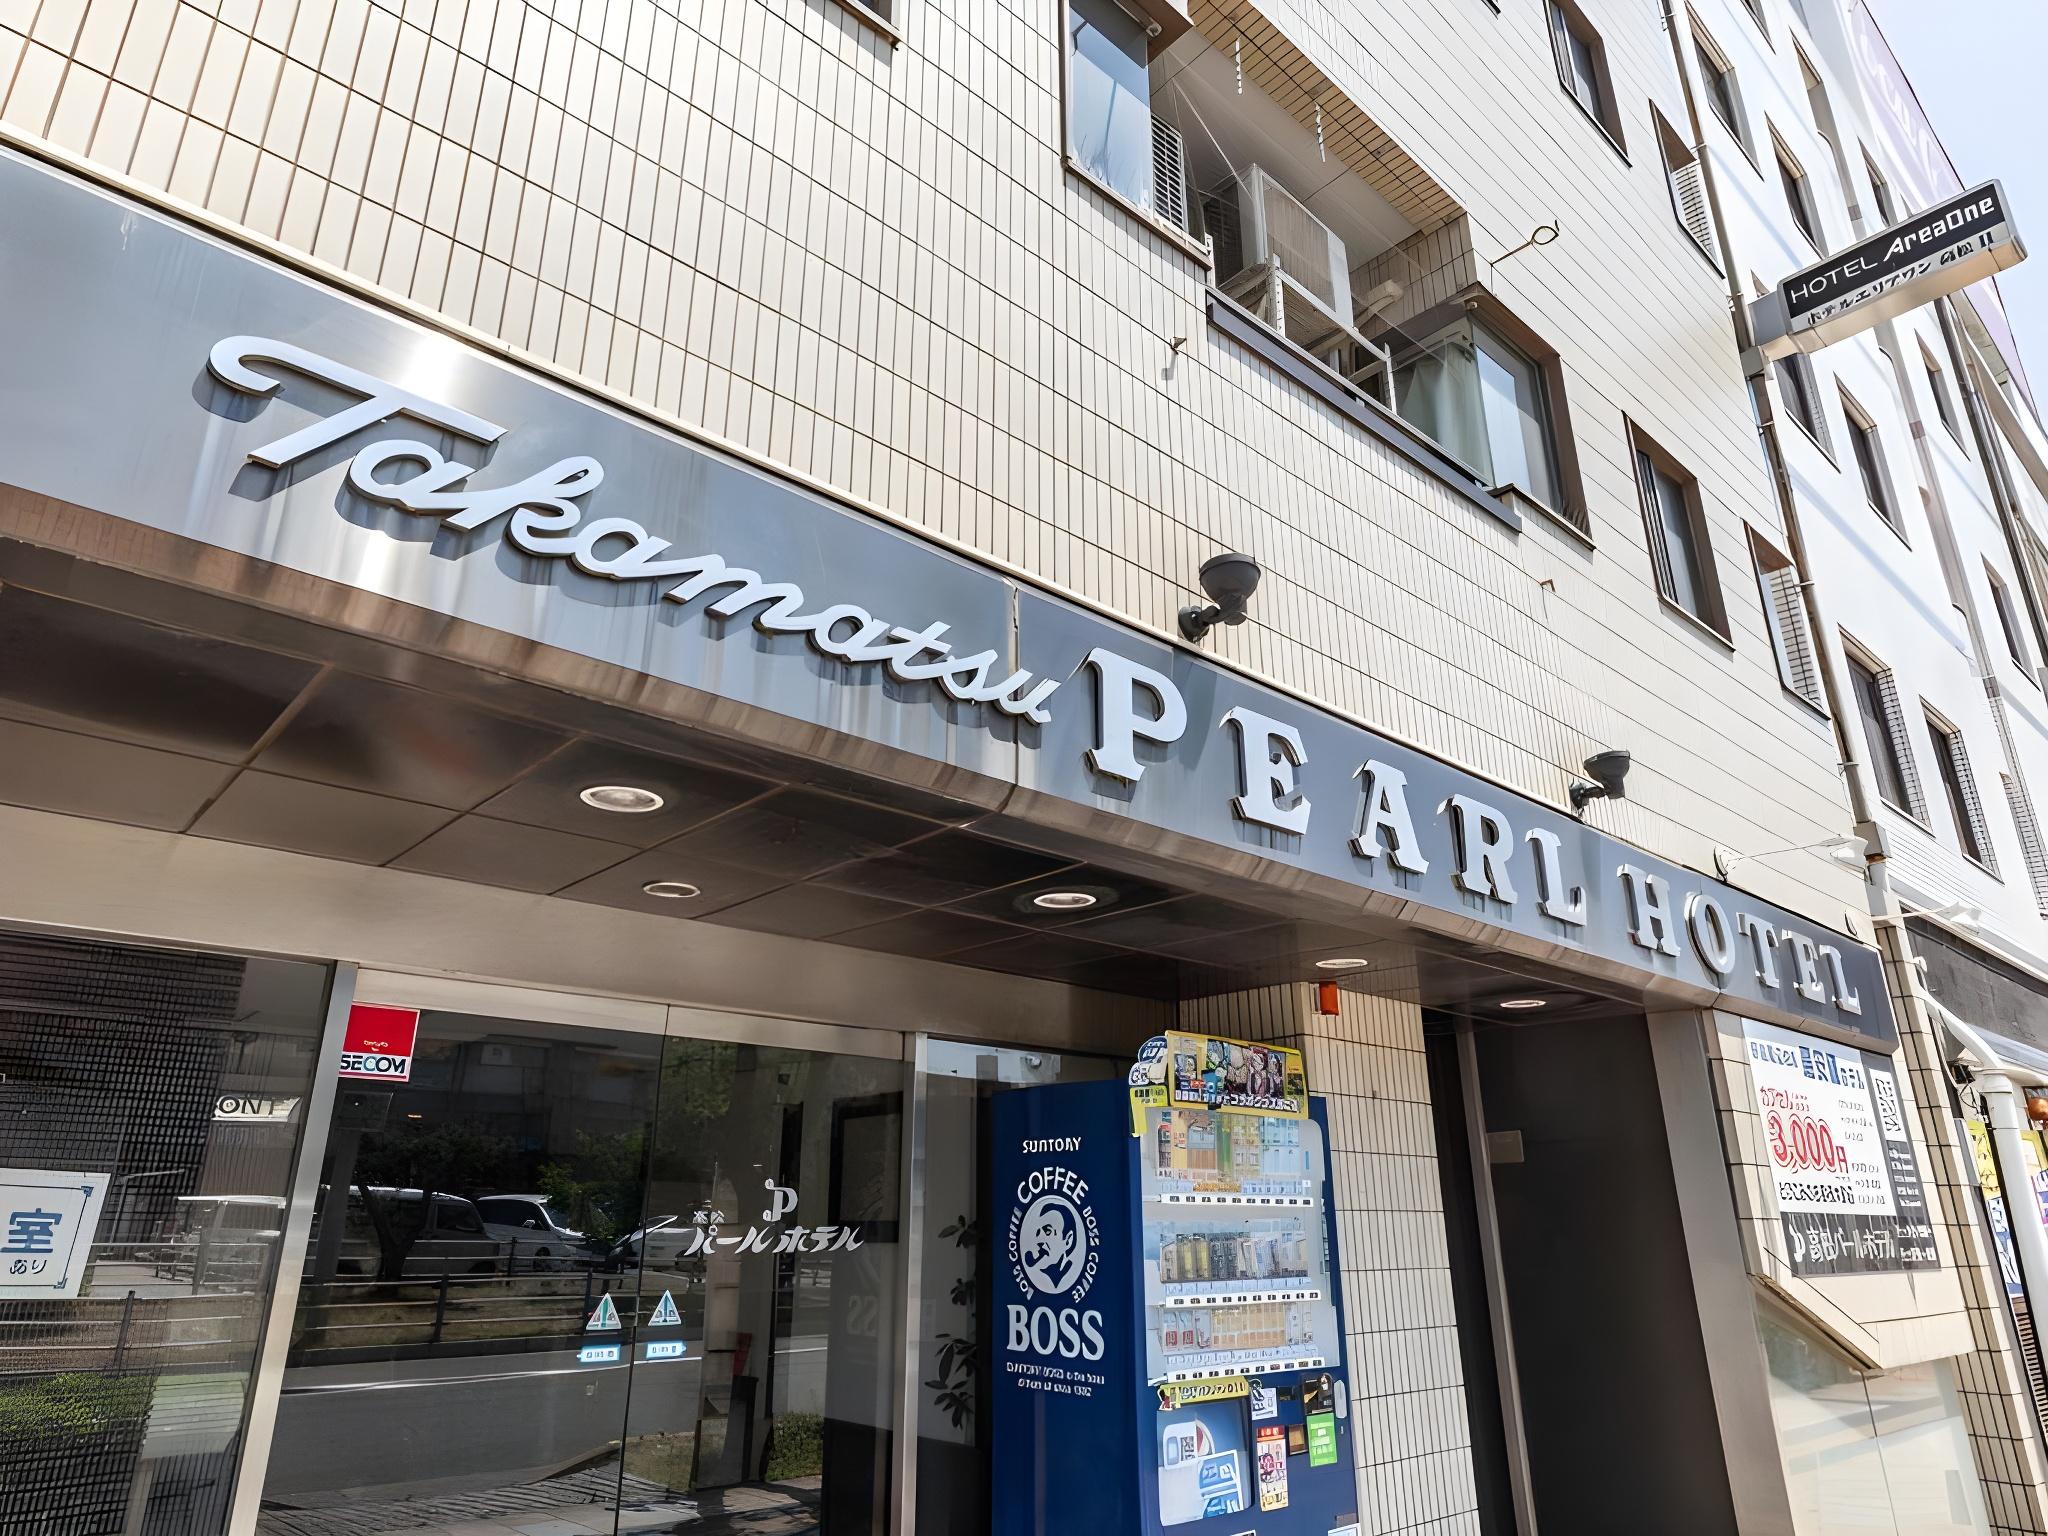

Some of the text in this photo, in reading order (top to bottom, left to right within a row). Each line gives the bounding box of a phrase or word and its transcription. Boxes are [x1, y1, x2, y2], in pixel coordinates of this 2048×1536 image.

[1790, 257, 1879, 304] HOTEL
[1883, 196, 1994, 262] AreaOne
[208, 335, 1862, 1015] Takamatsu PEARL HOTEL
[340, 1054, 407, 1074] SECOM
[1017, 1166, 1089, 1205] COFFEE
[0, 1207, 63, 1254] 室
[683, 1225, 864, 1256] パールホテル
[9, 1259, 48, 1275] あり
[1006, 1304, 1105, 1361] BOSS
